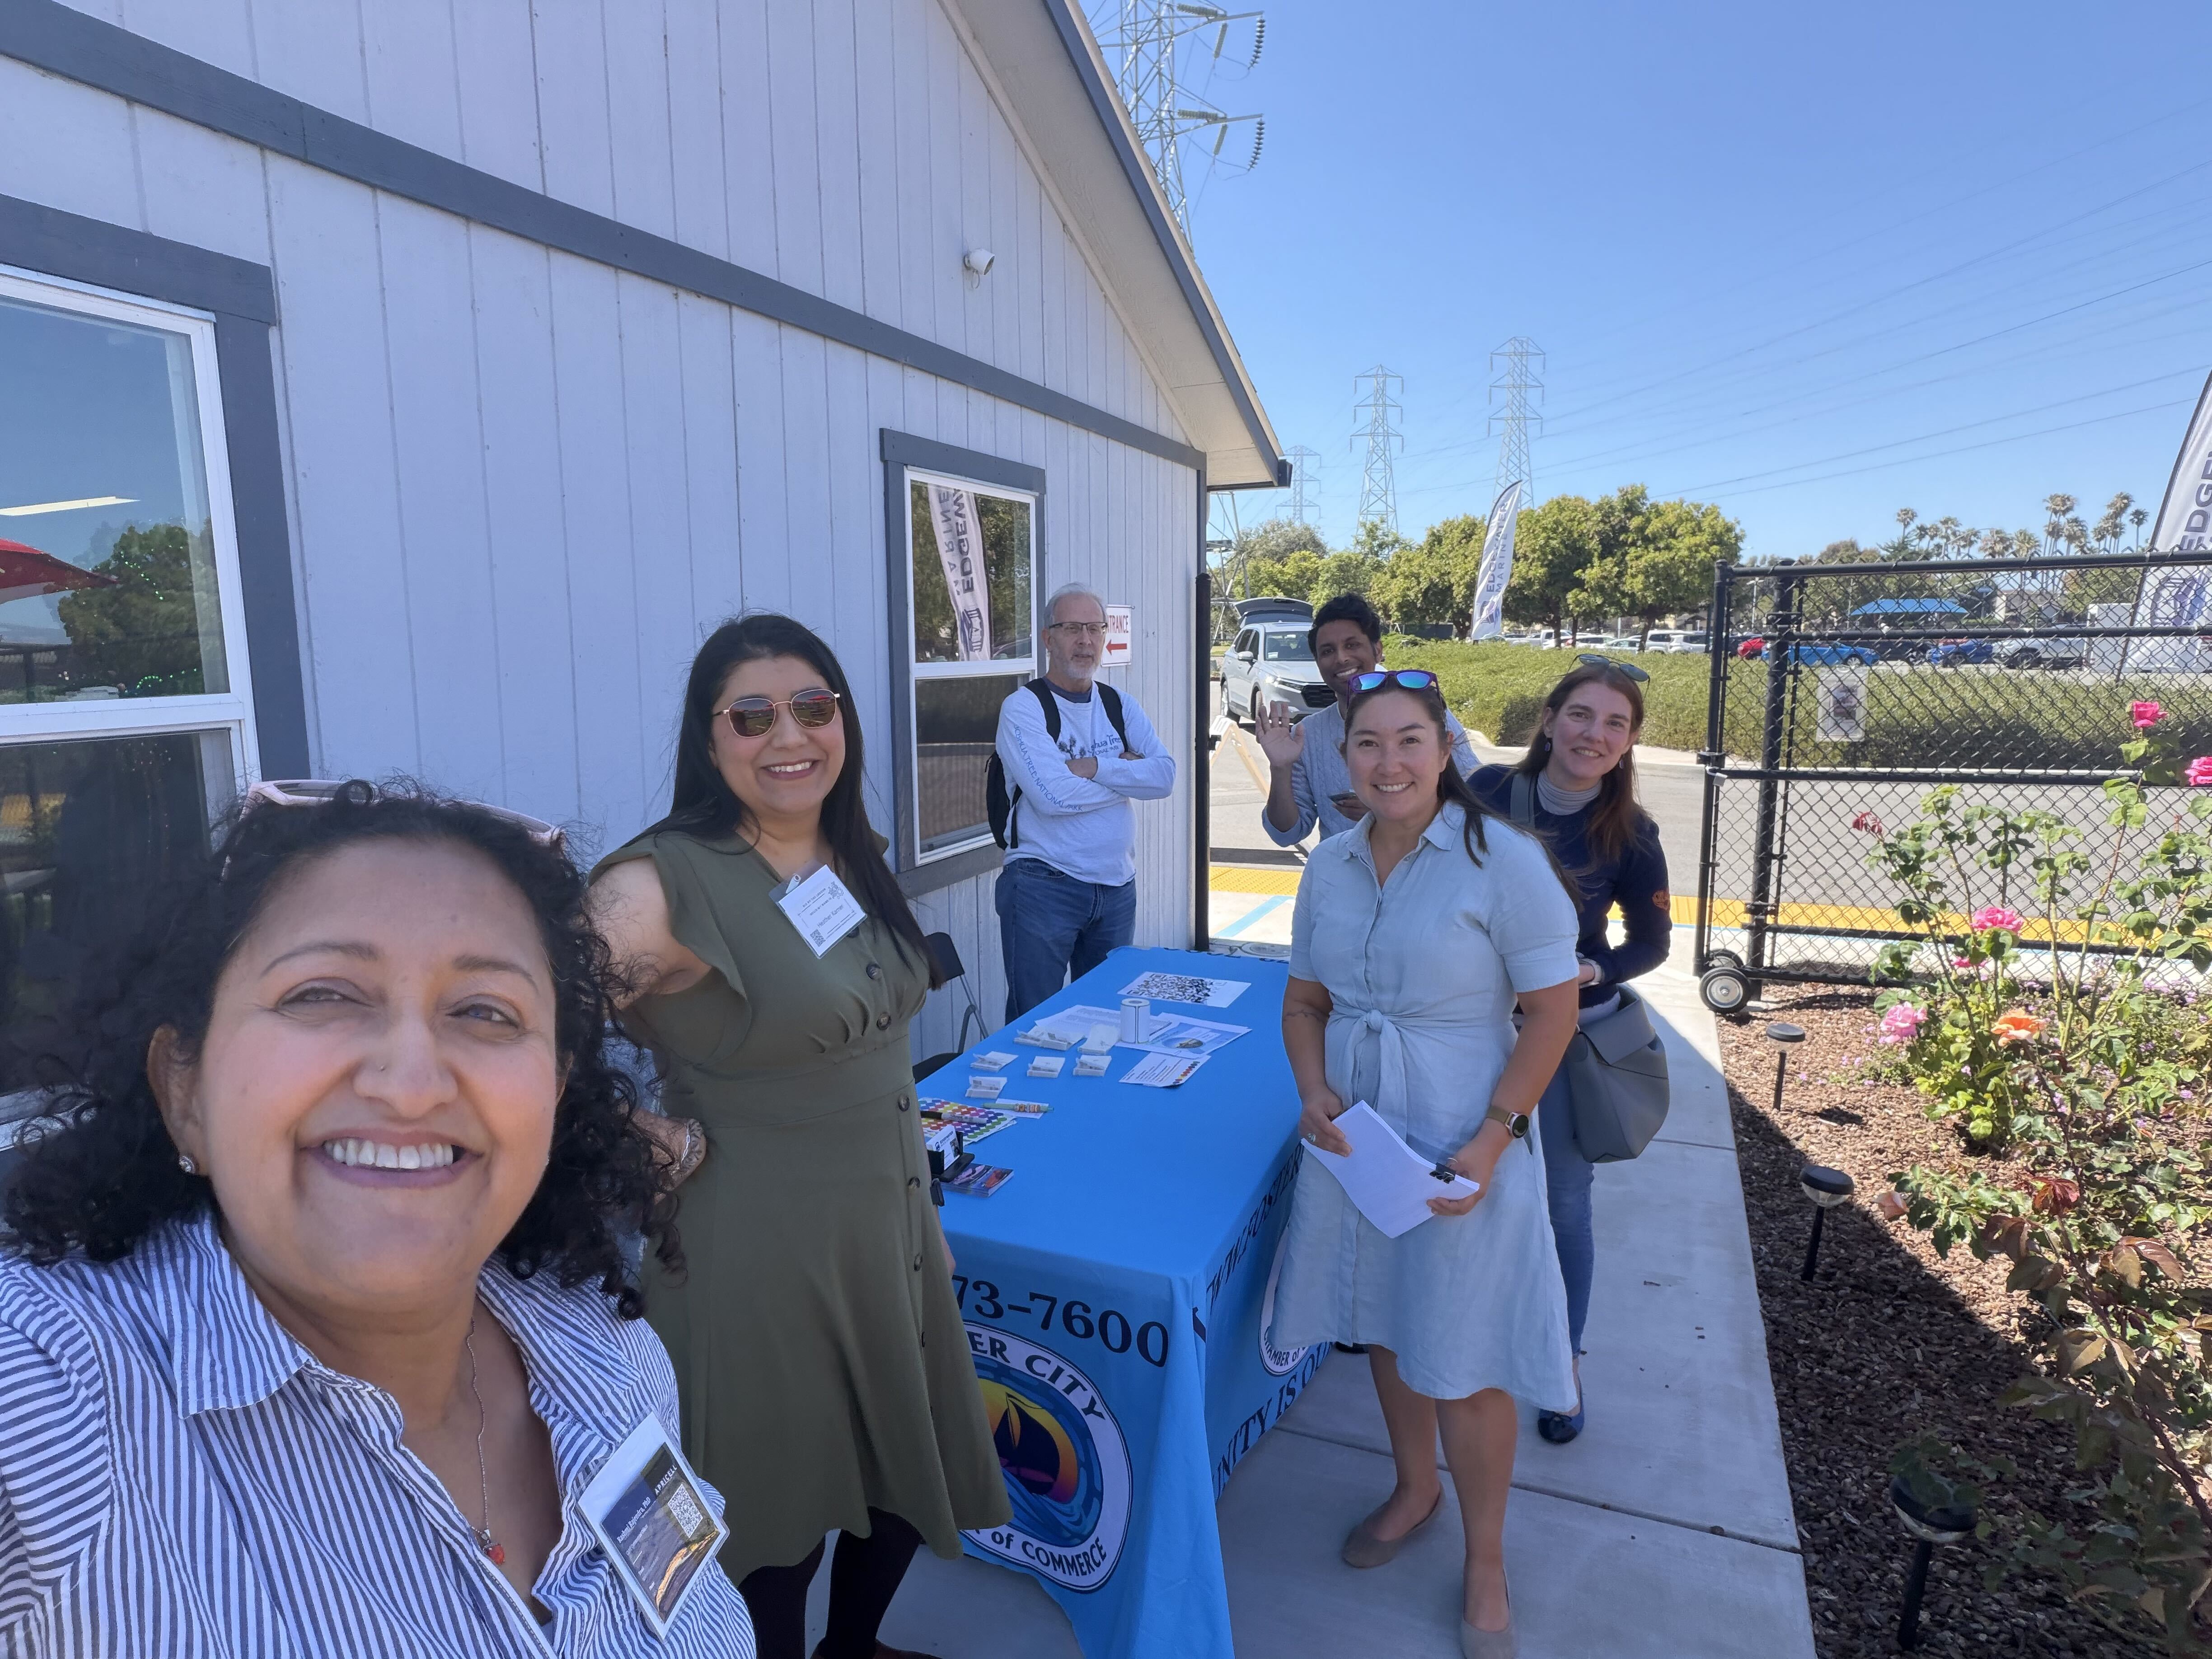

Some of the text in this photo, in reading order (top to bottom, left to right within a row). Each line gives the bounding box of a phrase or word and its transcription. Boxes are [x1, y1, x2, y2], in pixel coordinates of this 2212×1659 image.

[1495, 534, 1508, 592] MARINE
[1107, 615, 1129, 633] TRANCE
[1013, 723, 1028, 757] JOSHUA
[1025, 755, 1037, 778] TREE
[1034, 777, 1064, 808] NATIONAL
[1025, 1354, 1106, 1420] CITY
[1276, 1372, 1298, 1420] IS
[655, 1465, 677, 1495] APRICELL
[617, 1523, 630, 1543] Rashmi
[642, 1496, 651, 1510] PhD
[991, 1531, 1107, 1576] of COMMERCE
